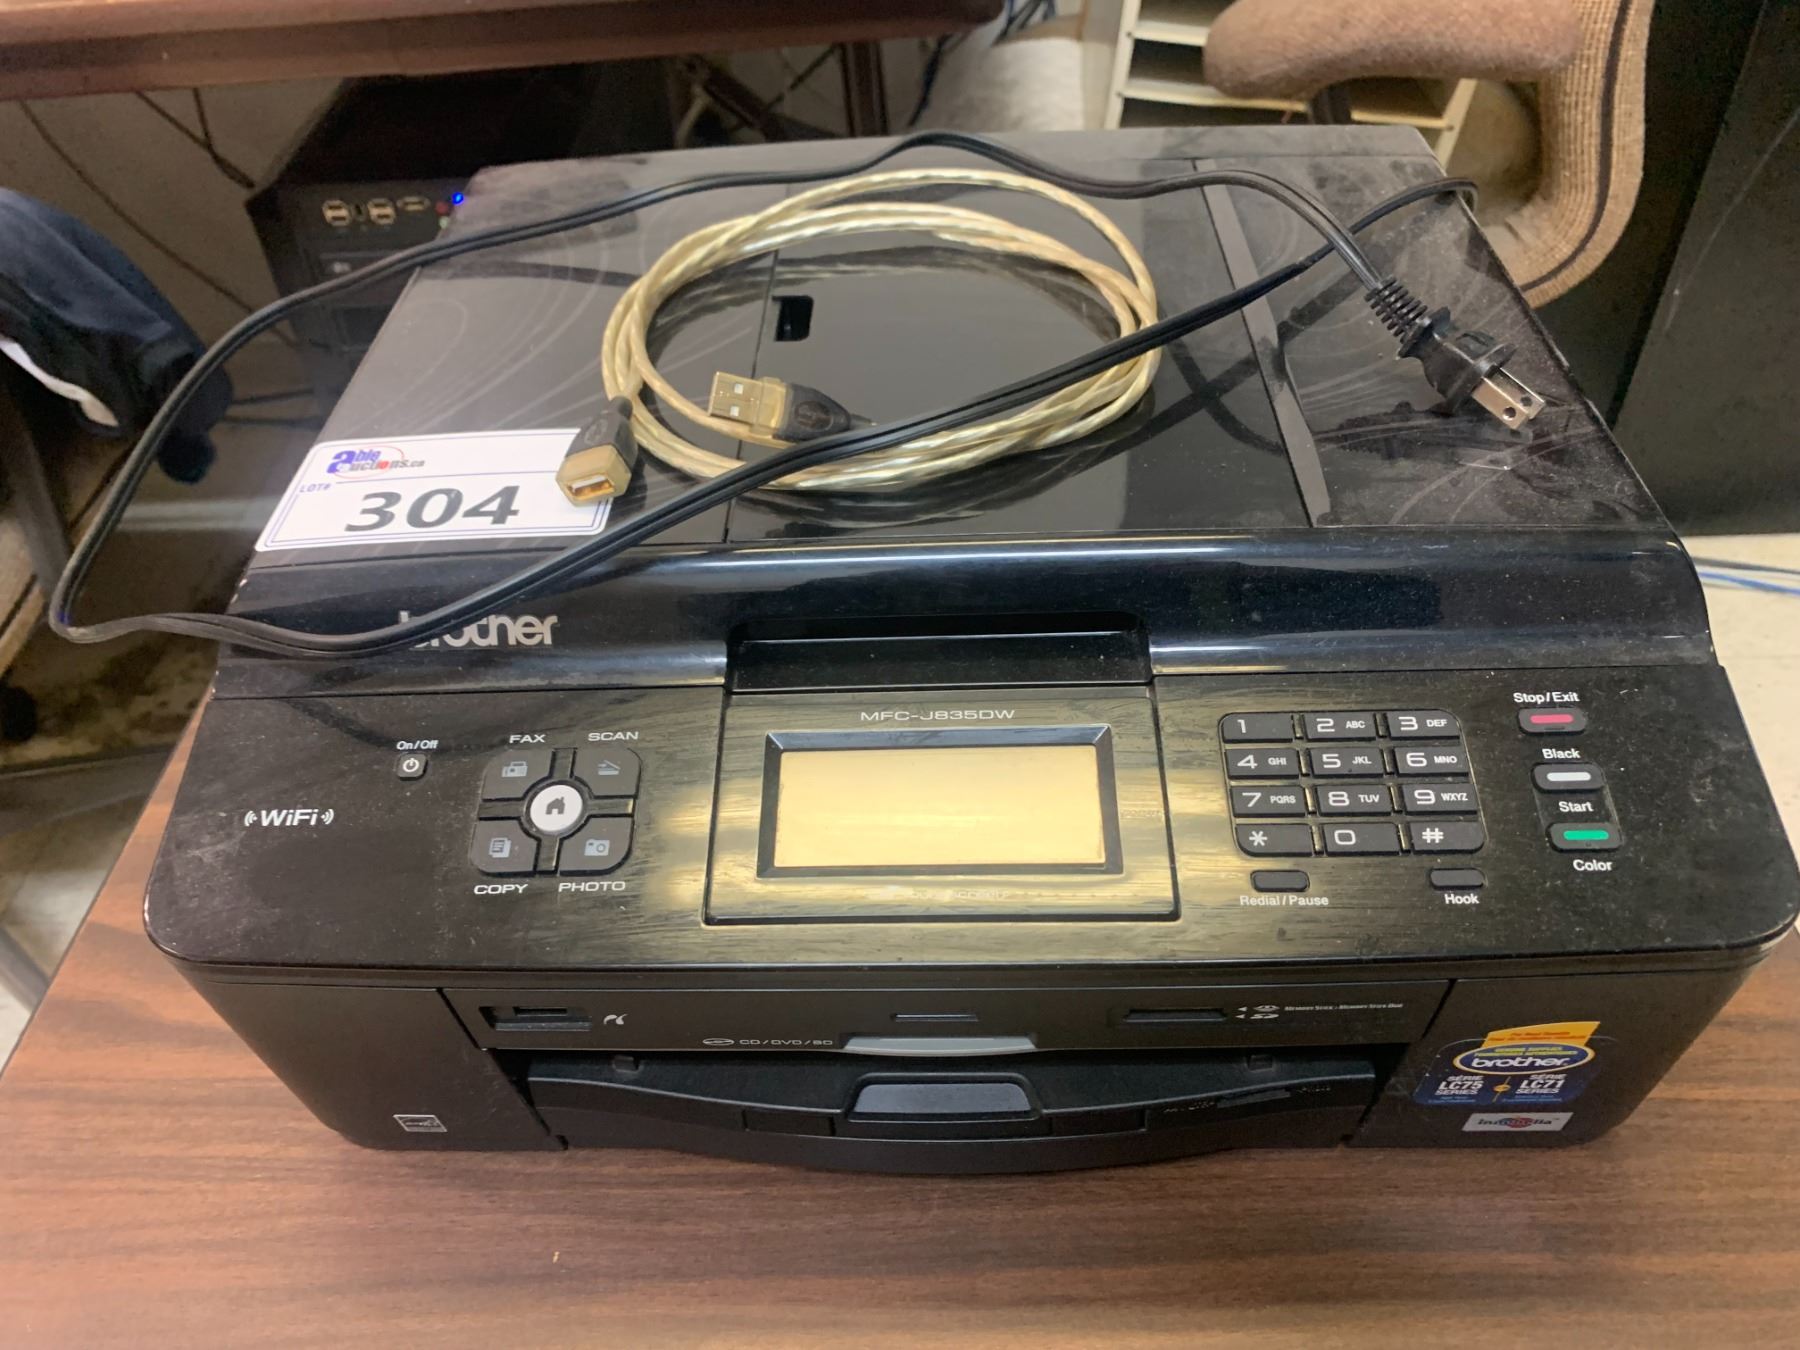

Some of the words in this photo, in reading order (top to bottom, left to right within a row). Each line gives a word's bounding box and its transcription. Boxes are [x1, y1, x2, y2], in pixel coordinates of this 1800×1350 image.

[345, 485, 520, 533] 304
[861, 709, 1015, 721] MFC-J835DW
[1237, 719, 1247, 733] 1
[1316, 717, 1336, 733] 2
[1345, 719, 1366, 730] ABC
[1399, 715, 1419, 731] 3
[1426, 718, 1448, 728] DEF
[509, 733, 546, 744] FAX
[588, 731, 639, 742] SCAN
[396, 738, 439, 750] On/Off
[1322, 753, 1342, 768] 5
[1352, 756, 1372, 765] JKL
[1406, 752, 1427, 767] 6
[1433, 755, 1458, 764] MNO
[1542, 748, 1580, 760] Black
[1237, 754, 1258, 769] 4
[1268, 757, 1287, 766] GHI
[1242, 792, 1262, 807] 7
[1270, 794, 1296, 805] PQRS
[1328, 790, 1350, 806] 8
[1358, 794, 1380, 803] TUV
[1414, 789, 1436, 805] 9
[1440, 791, 1468, 802] WXYZ
[1558, 800, 1593, 813] Start
[260, 808, 319, 827] WiFi
[1572, 858, 1612, 872] Color
[473, 883, 529, 895] COPY
[558, 880, 627, 892] PHOTO
[1444, 892, 1480, 905] Hook
[1471, 1056, 1570, 1068] brother
[1438, 1080, 1484, 1090] LC75
[1519, 1079, 1565, 1089] LC71
